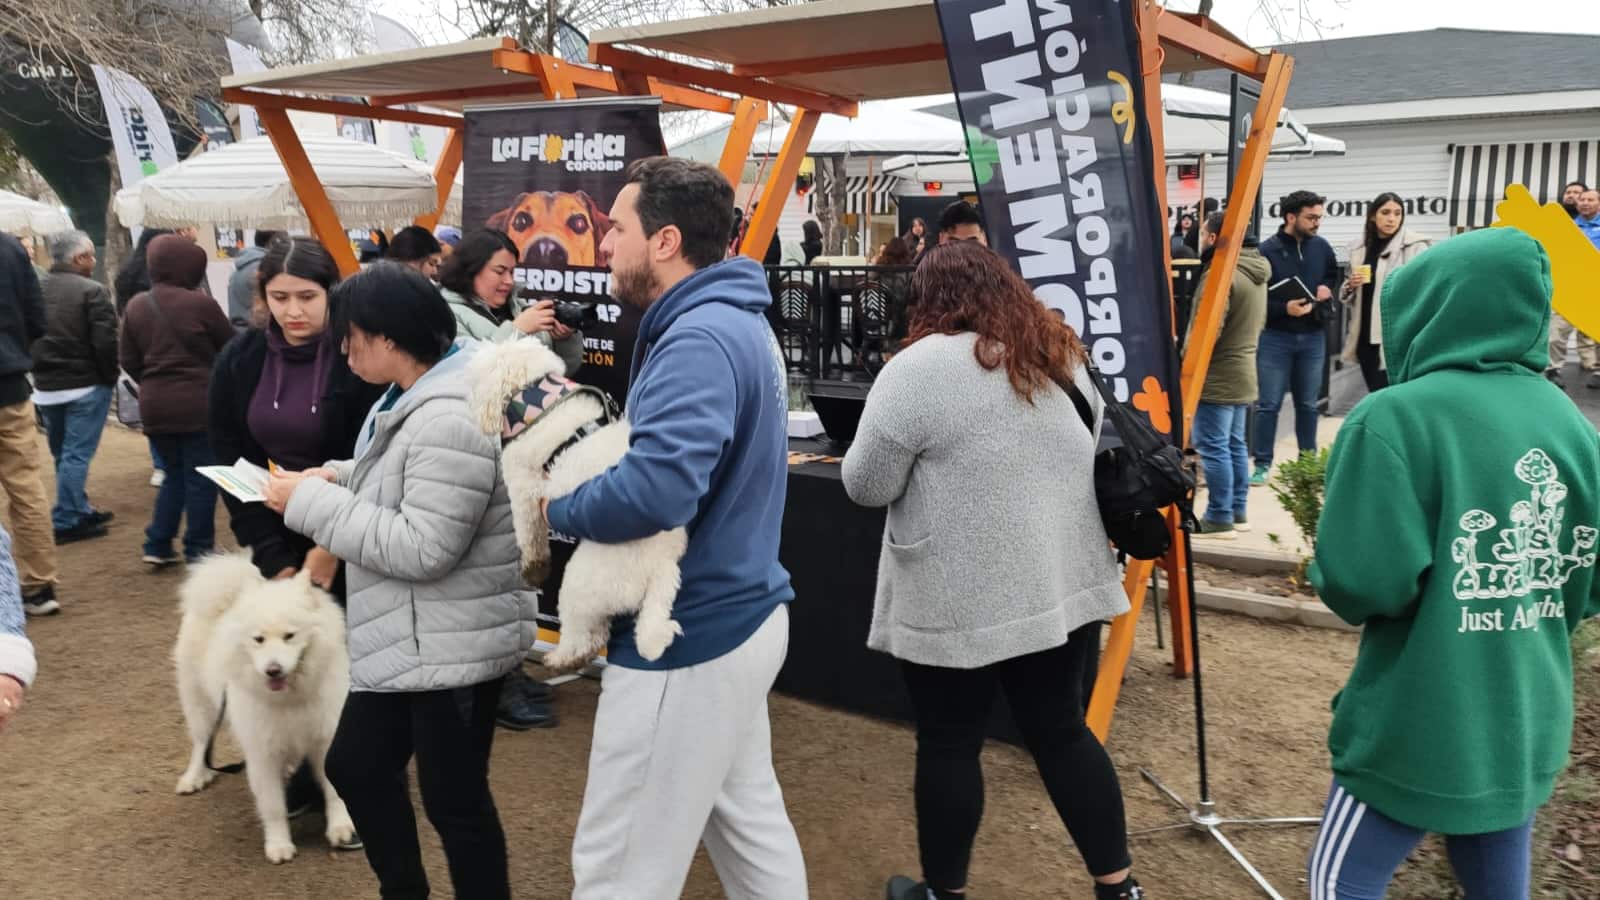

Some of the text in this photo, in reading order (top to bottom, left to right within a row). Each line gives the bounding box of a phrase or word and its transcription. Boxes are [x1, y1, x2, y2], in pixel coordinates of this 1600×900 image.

[565, 160, 625, 172] COFODEP
[512, 267, 612, 295] ERDIST
[600, 339, 616, 352] DE
[1458, 606, 1505, 633] Just
